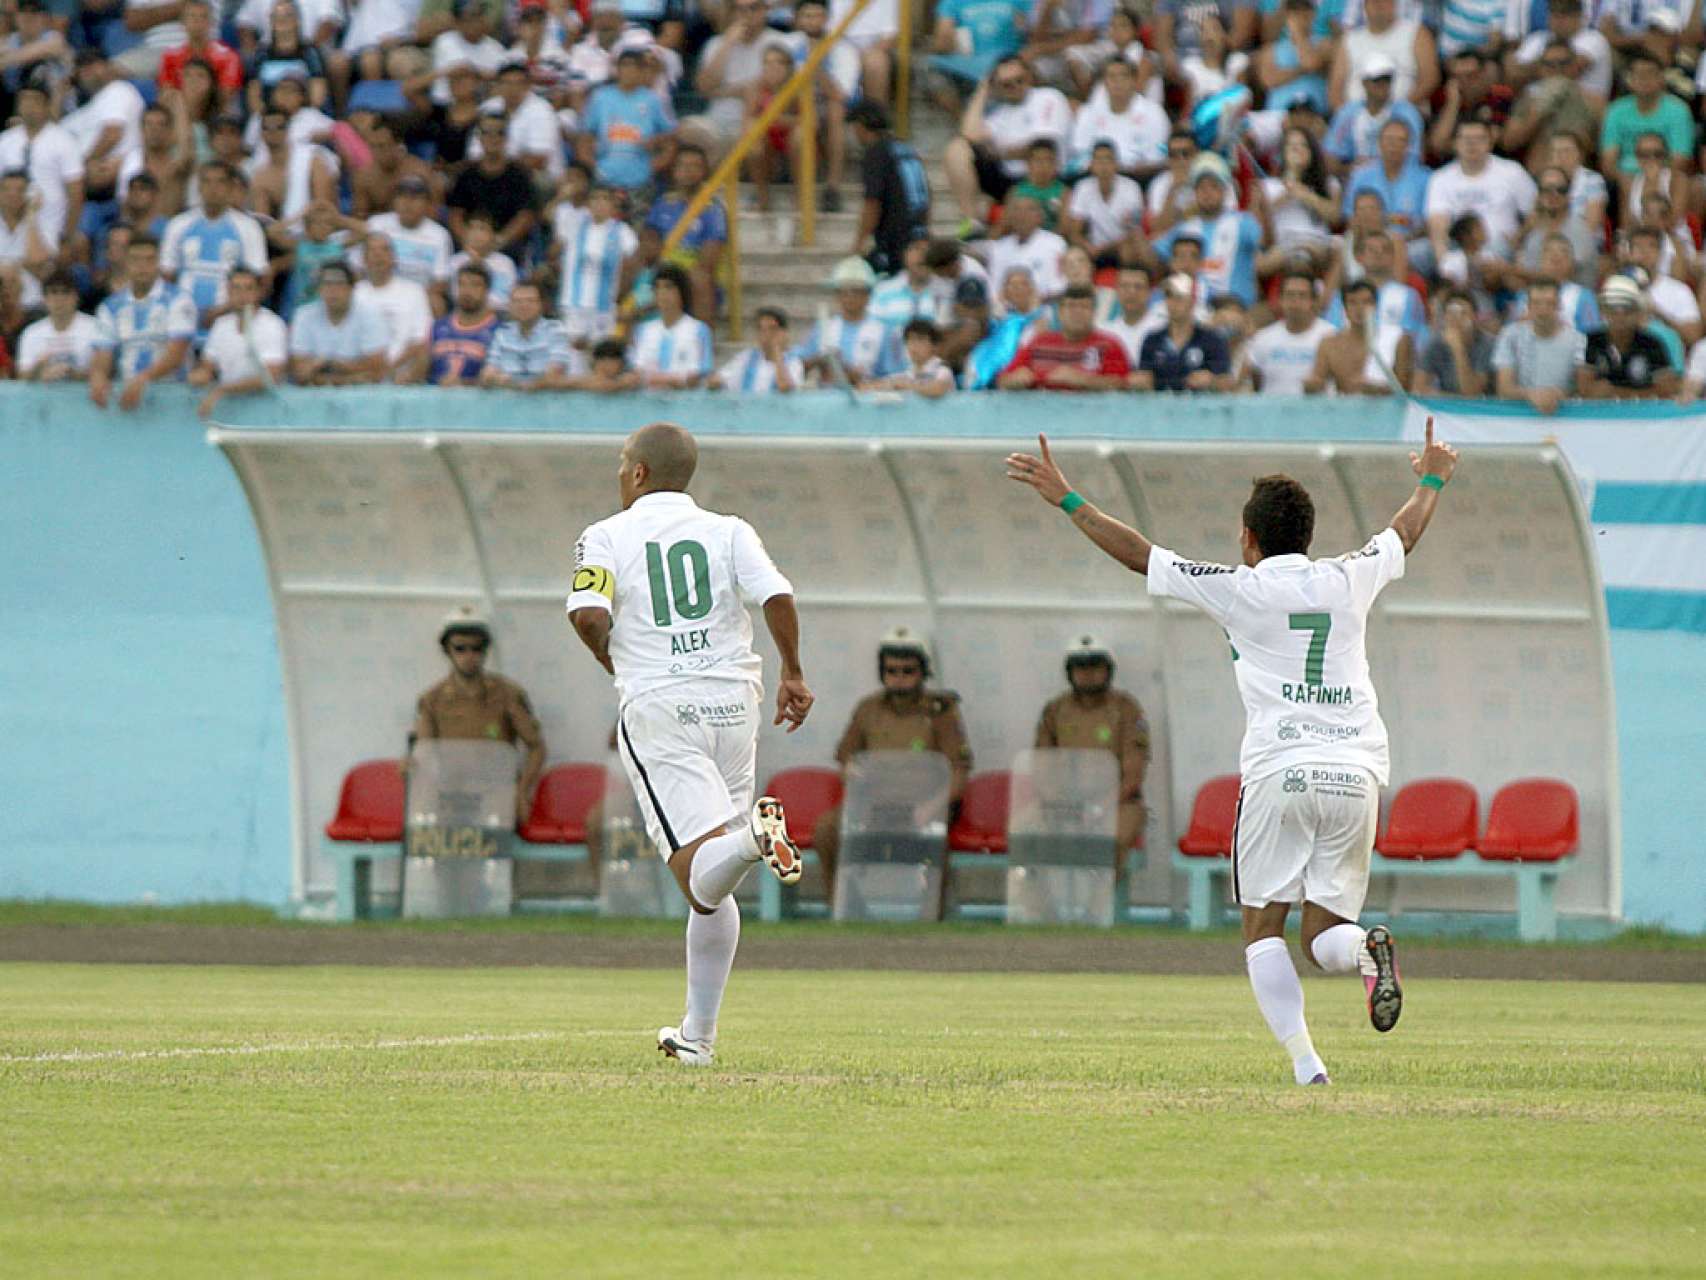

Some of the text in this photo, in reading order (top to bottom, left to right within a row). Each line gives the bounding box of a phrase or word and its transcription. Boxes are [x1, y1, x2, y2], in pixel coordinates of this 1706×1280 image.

[645, 539, 713, 627] 10
[670, 628, 711, 656] ALEX
[1288, 612, 1332, 685] 7
[1282, 682, 1353, 705] RAFINHA
